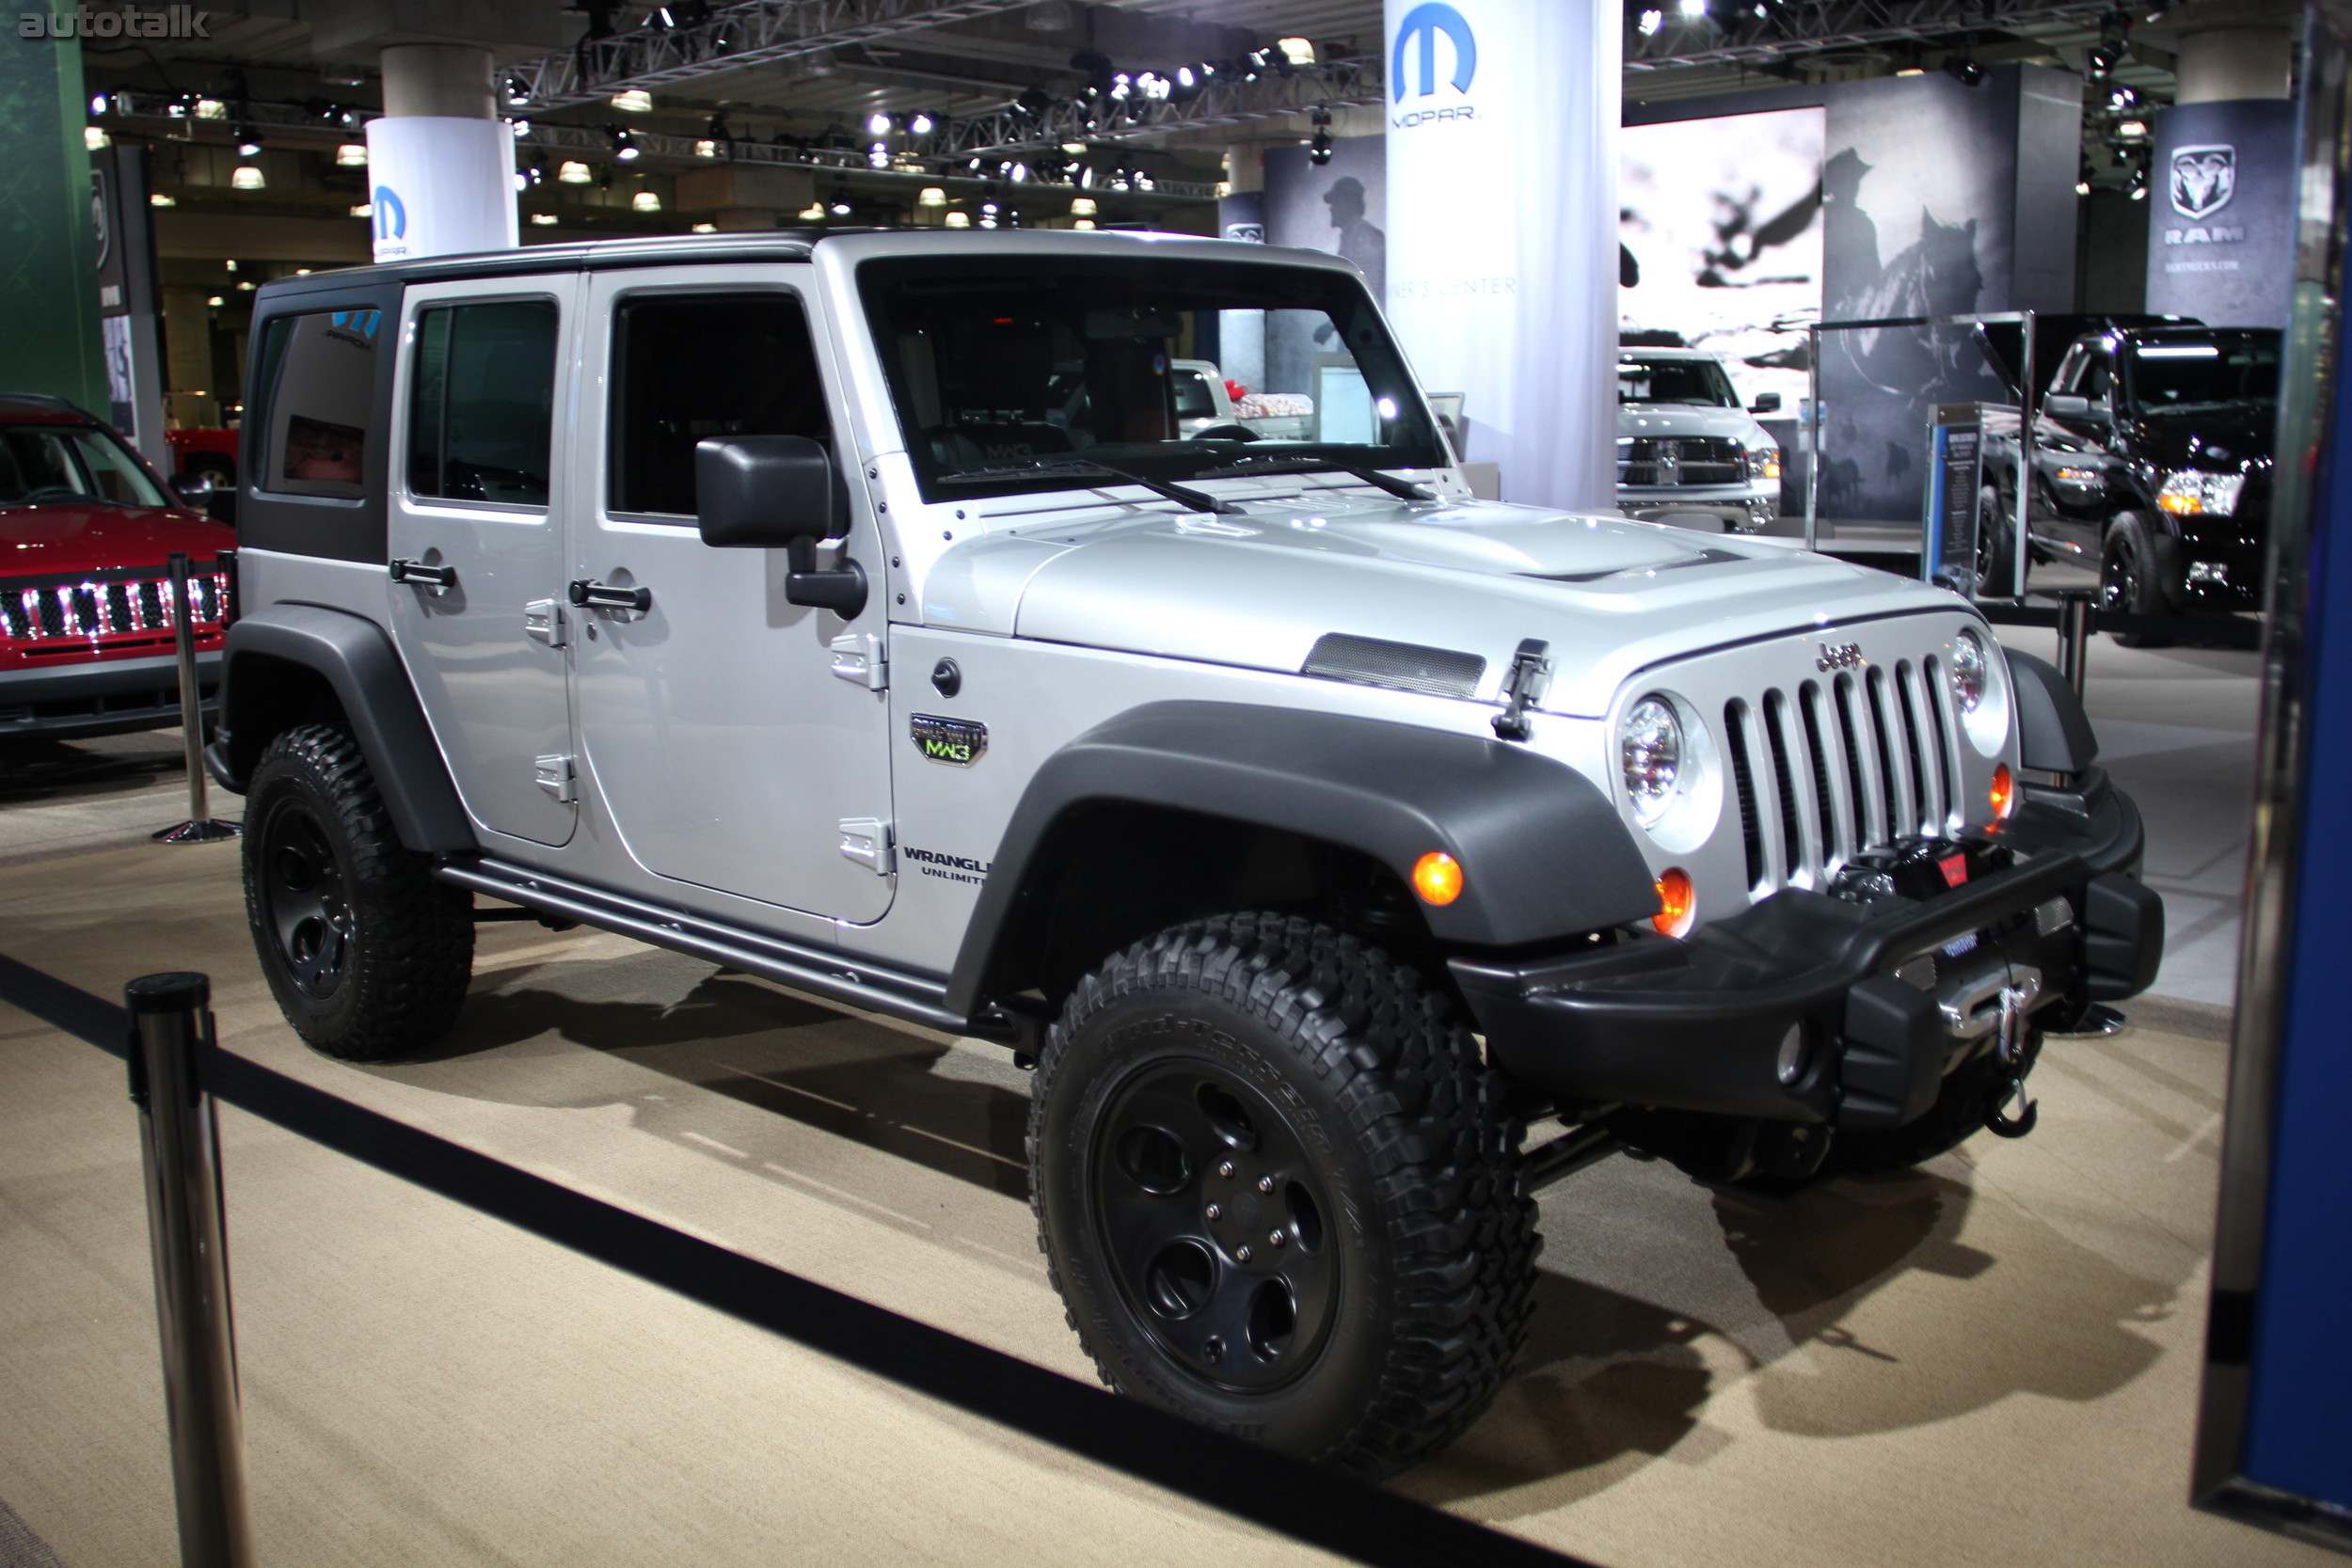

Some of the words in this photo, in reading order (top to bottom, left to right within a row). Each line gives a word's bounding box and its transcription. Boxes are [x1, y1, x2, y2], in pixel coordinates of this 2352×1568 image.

[1391, 105, 1474, 129] MOPAR
[2165, 227, 2245, 245] RAM
[1437, 277, 1517, 296] CENTER
[1815, 641, 1862, 673] Jeep
[926, 738, 970, 761] MW3
